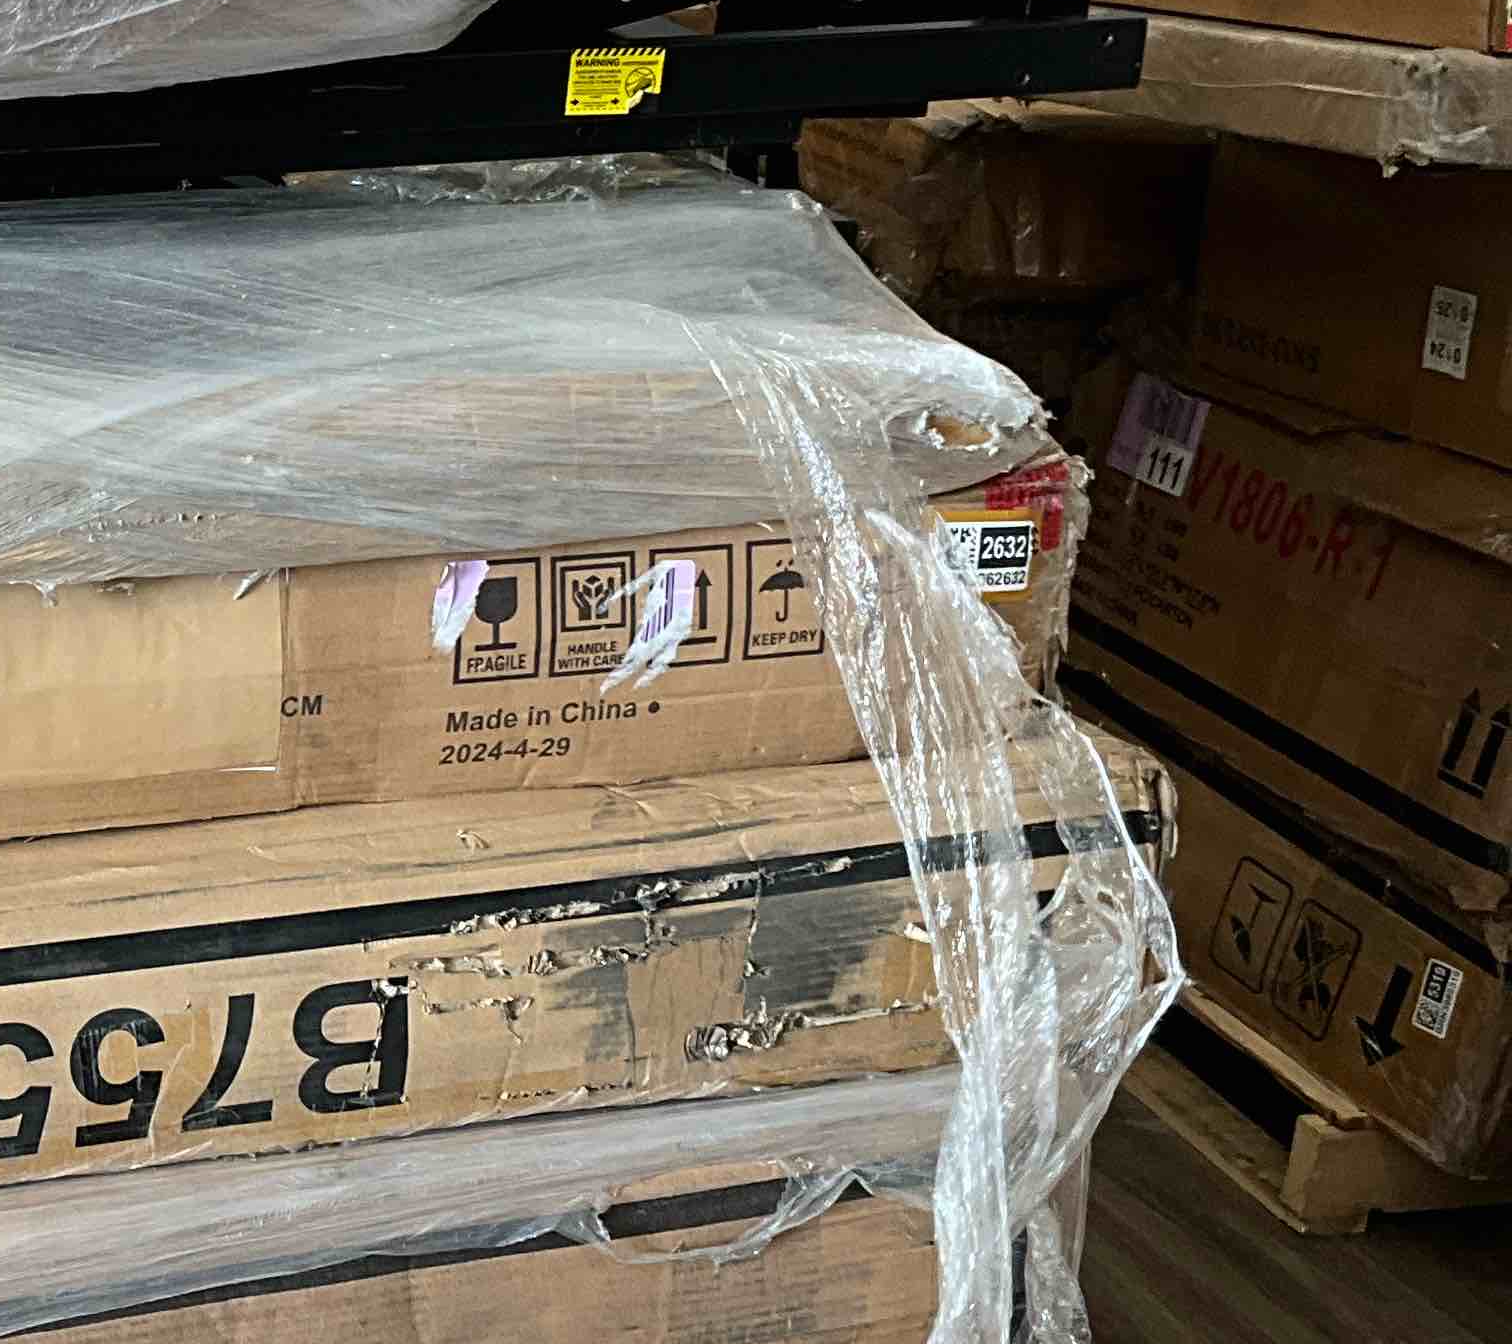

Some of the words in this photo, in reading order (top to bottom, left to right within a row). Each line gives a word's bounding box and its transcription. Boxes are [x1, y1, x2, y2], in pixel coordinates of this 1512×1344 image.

[575, 58, 621, 68] WARNING
[1146, 447, 1186, 490] 111
[981, 535, 1027, 560] 2632
[567, 640, 617, 655] HANDLE
[751, 631, 786, 648] KEEP
[789, 629, 818, 645] DRY
[466, 653, 527, 673] FRAGILE
[557, 657, 589, 670] WITH
[592, 654, 625, 667] CARE
[280, 694, 323, 721] CM
[445, 709, 518, 734] Made
[527, 706, 552, 727] in
[561, 699, 638, 724] China
[439, 736, 571, 766] 2024-4-29
